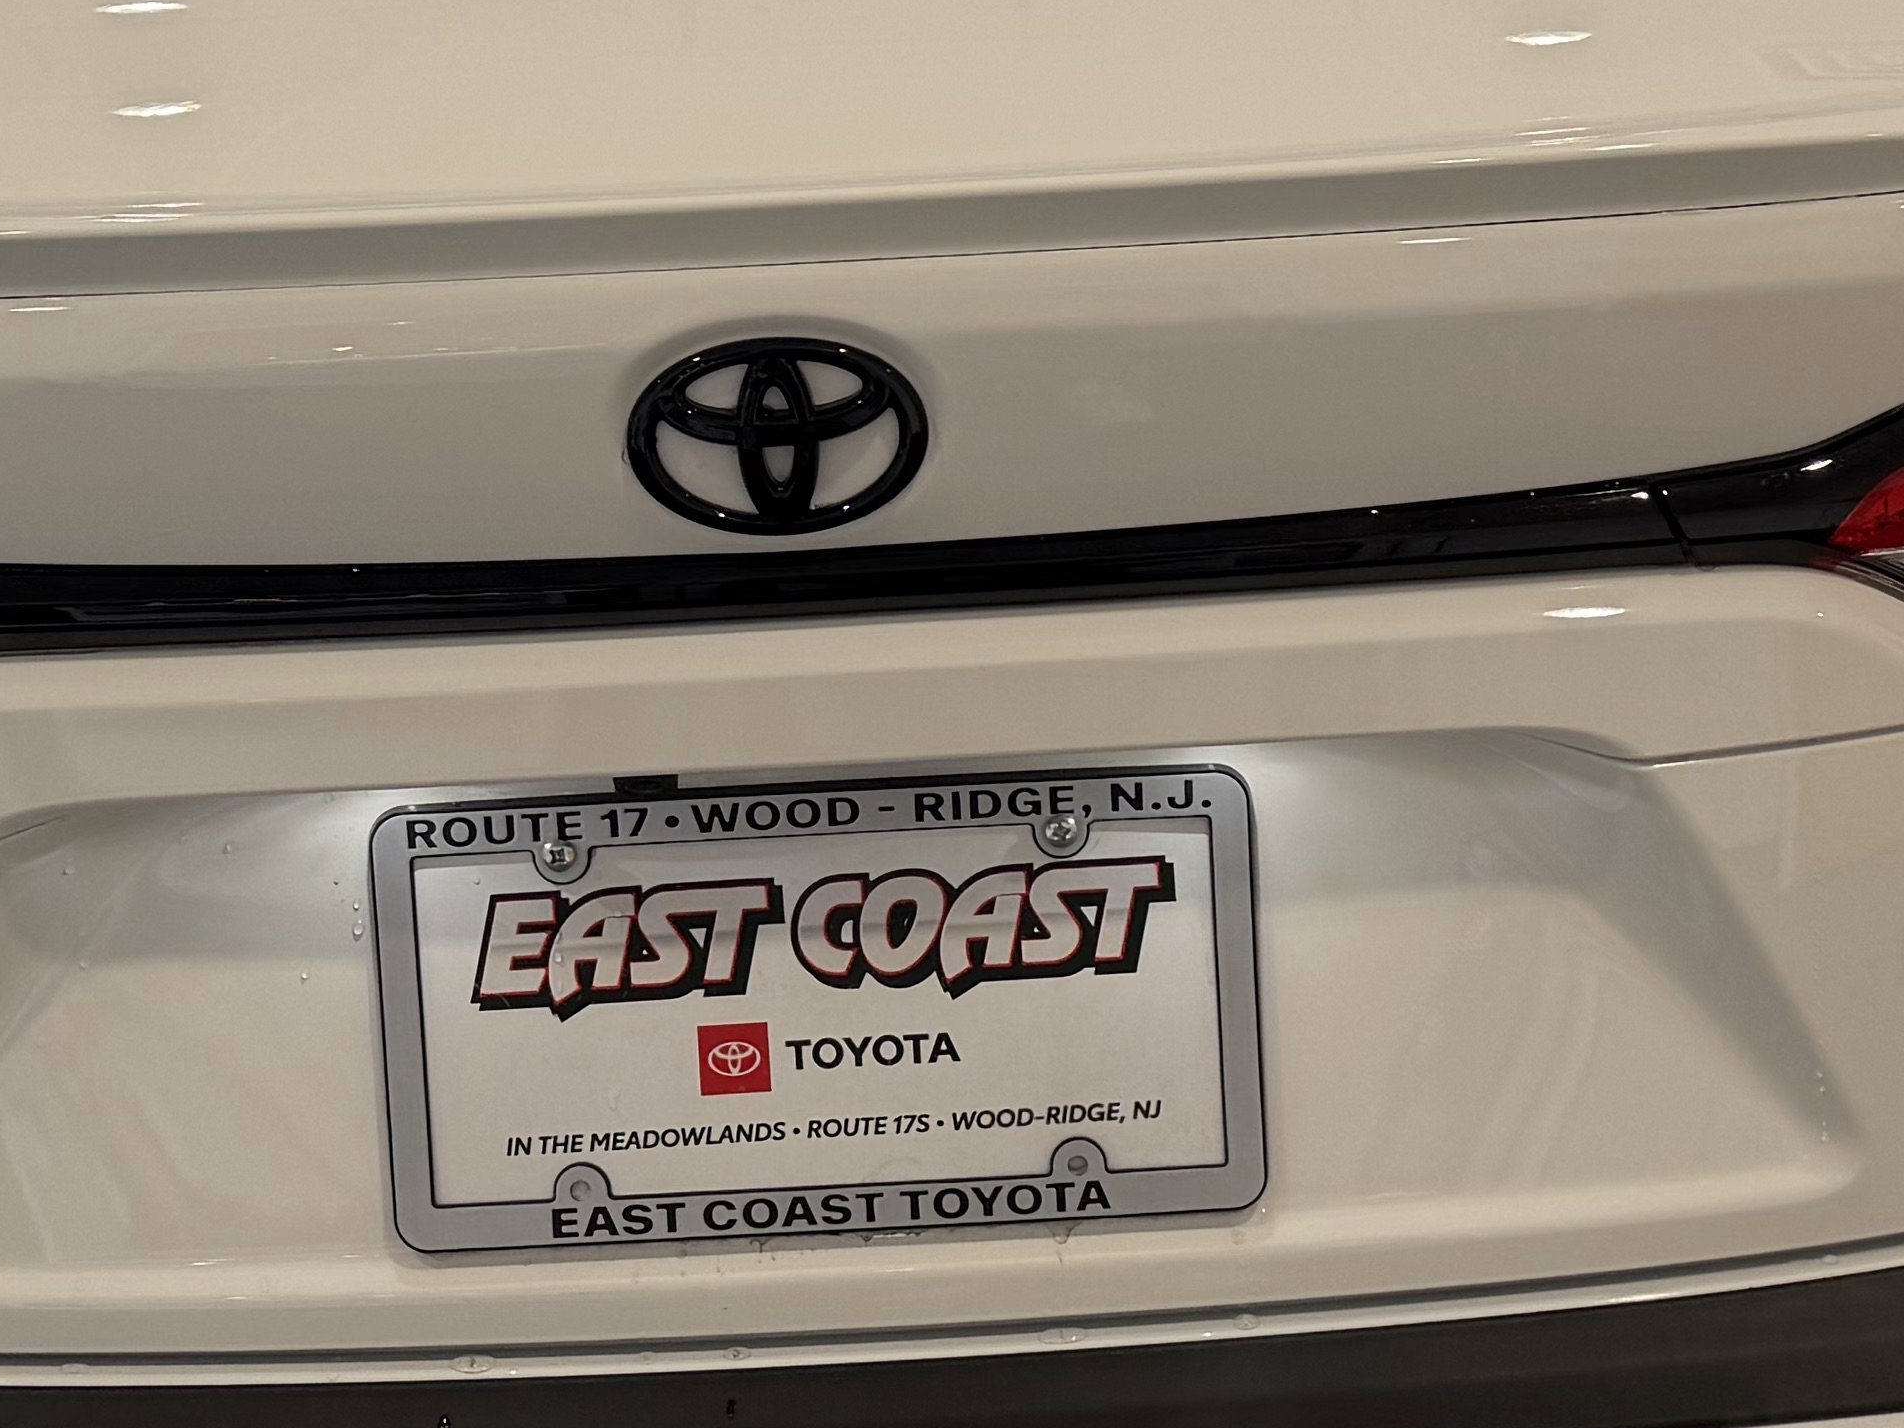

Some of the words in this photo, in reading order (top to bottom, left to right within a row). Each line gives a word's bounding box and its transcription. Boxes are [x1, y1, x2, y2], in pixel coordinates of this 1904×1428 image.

[406, 810, 584, 849] ROUTE
[600, 807, 649, 839] 17
[691, 796, 861, 833] WOOD
[913, 785, 1092, 822] RIDGE,
[1110, 779, 1213, 813] N.J.
[472, 877, 786, 1022] EAST
[790, 855, 1177, 1000] COAST
[785, 1032, 961, 1070] TOYOTA
[506, 1136, 532, 1157] IN
[539, 1133, 584, 1155] THE
[590, 1121, 787, 1153] MEADOWLANDS
[807, 1115, 888, 1139] ROUTE
[893, 1113, 930, 1135] 17S
[952, 1101, 1126, 1131] WOOD-RIDGE,
[1133, 1099, 1162, 1120] NJ
[552, 1201, 686, 1239] EAST
[702, 1191, 884, 1232] COAST
[899, 1179, 1112, 1221] TOYOTA
